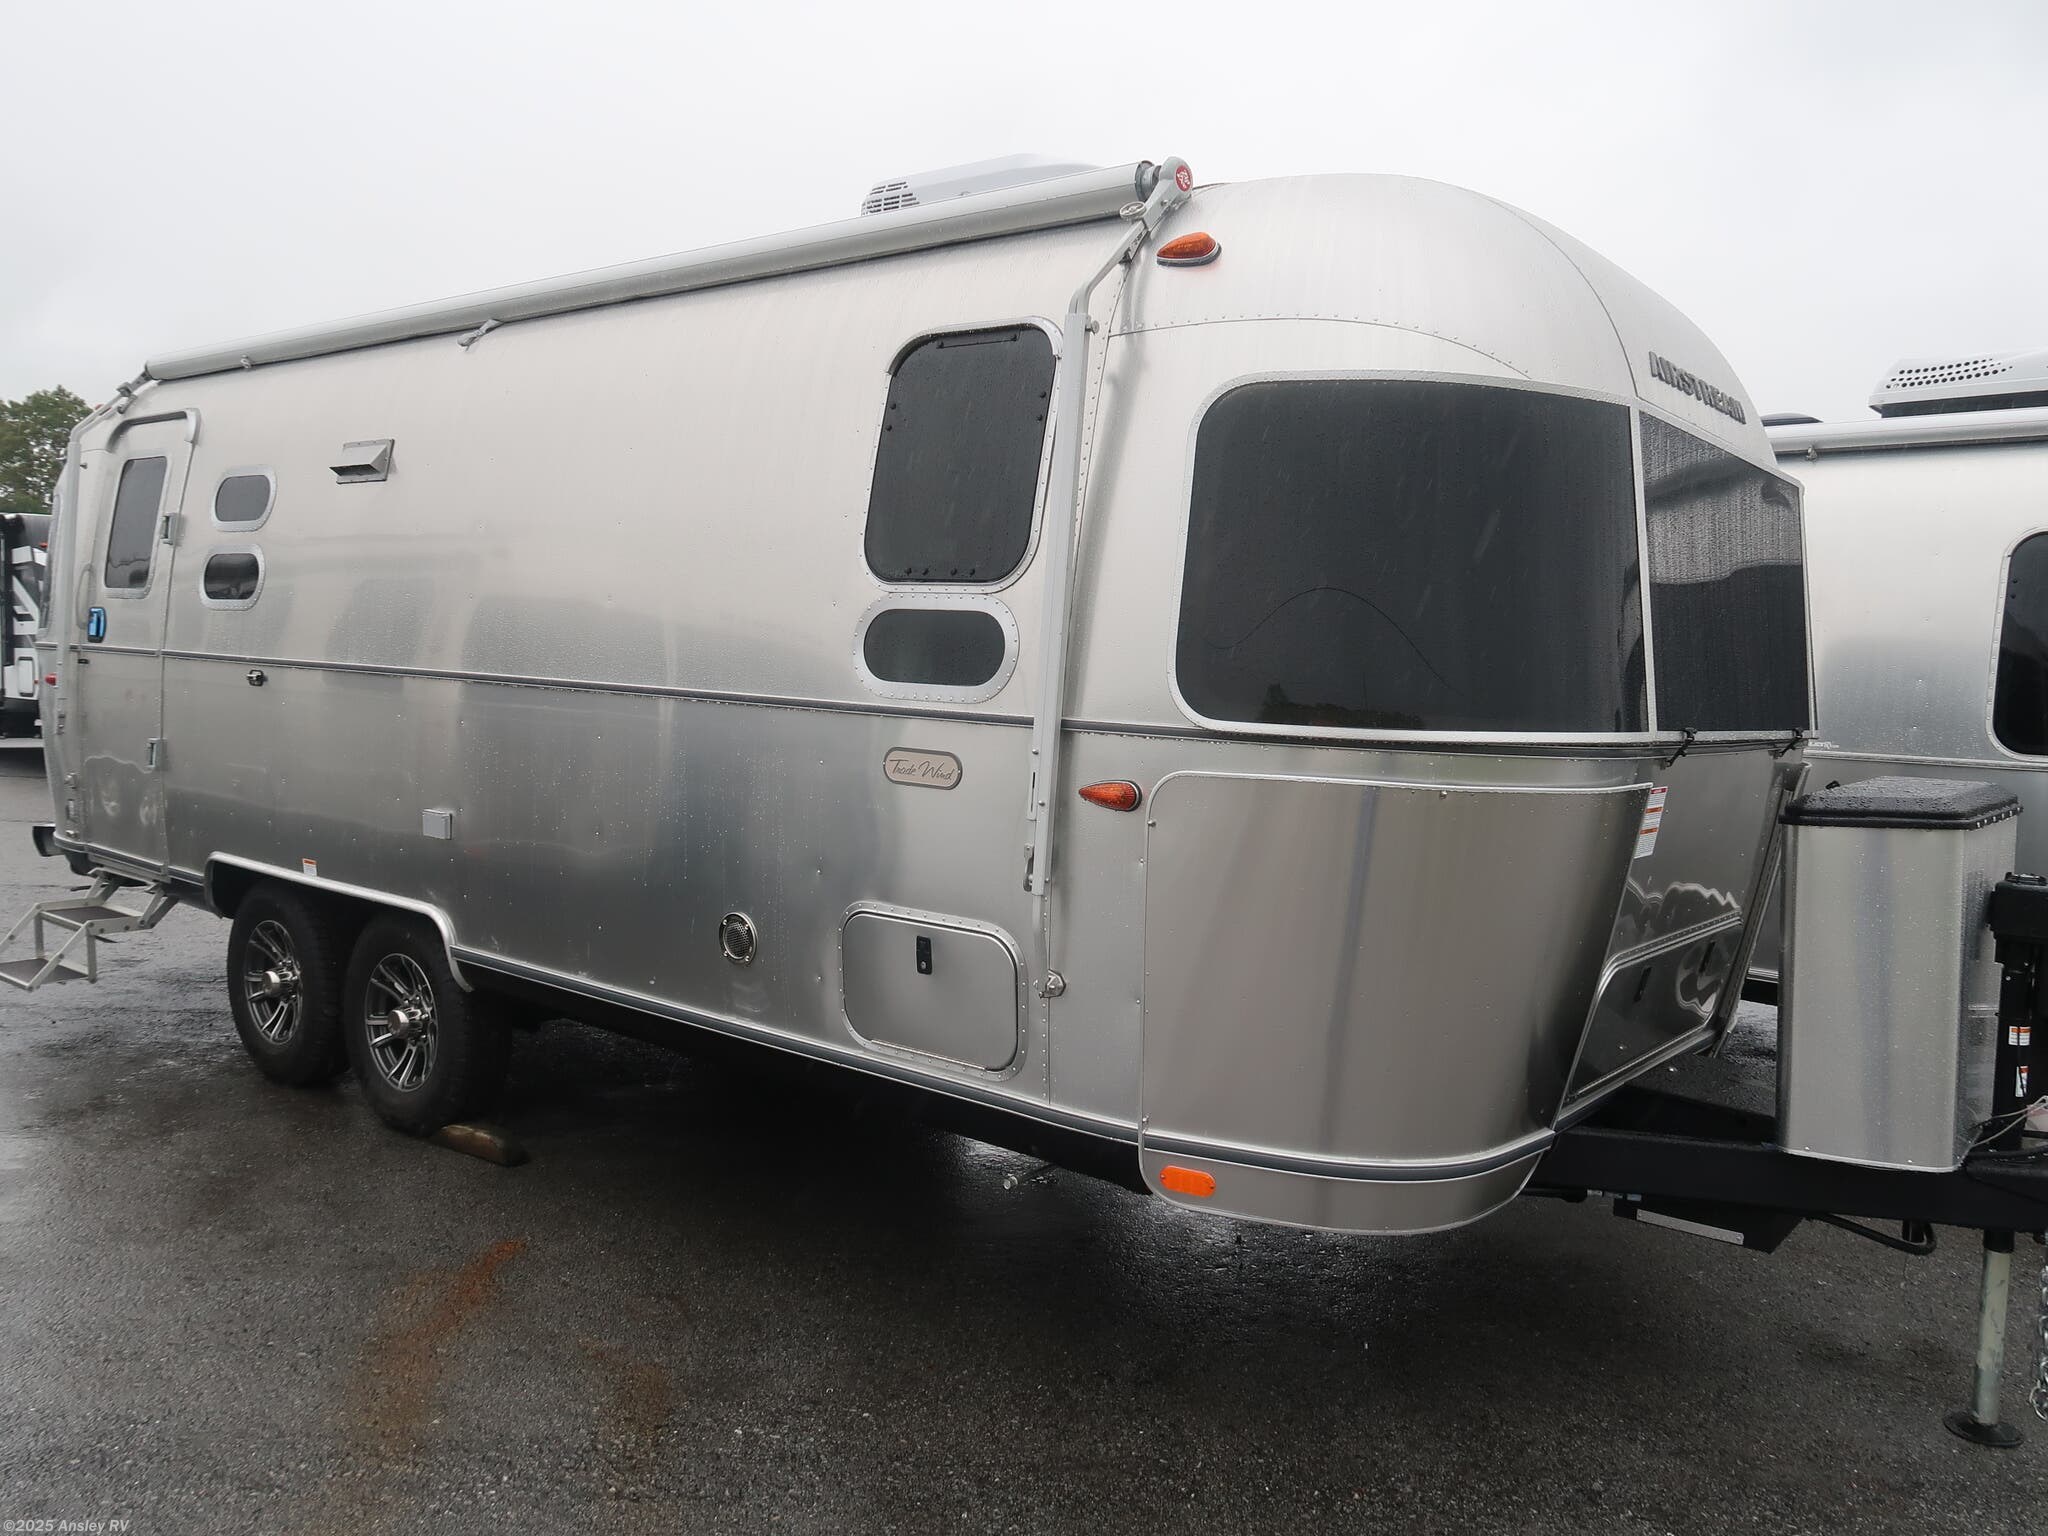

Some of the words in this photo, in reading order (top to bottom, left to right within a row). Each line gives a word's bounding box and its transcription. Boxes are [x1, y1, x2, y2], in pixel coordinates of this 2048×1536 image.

[1649, 351, 1747, 425] AIRSTREAM
[889, 758, 917, 775] Trade
[918, 760, 955, 781] Wind
